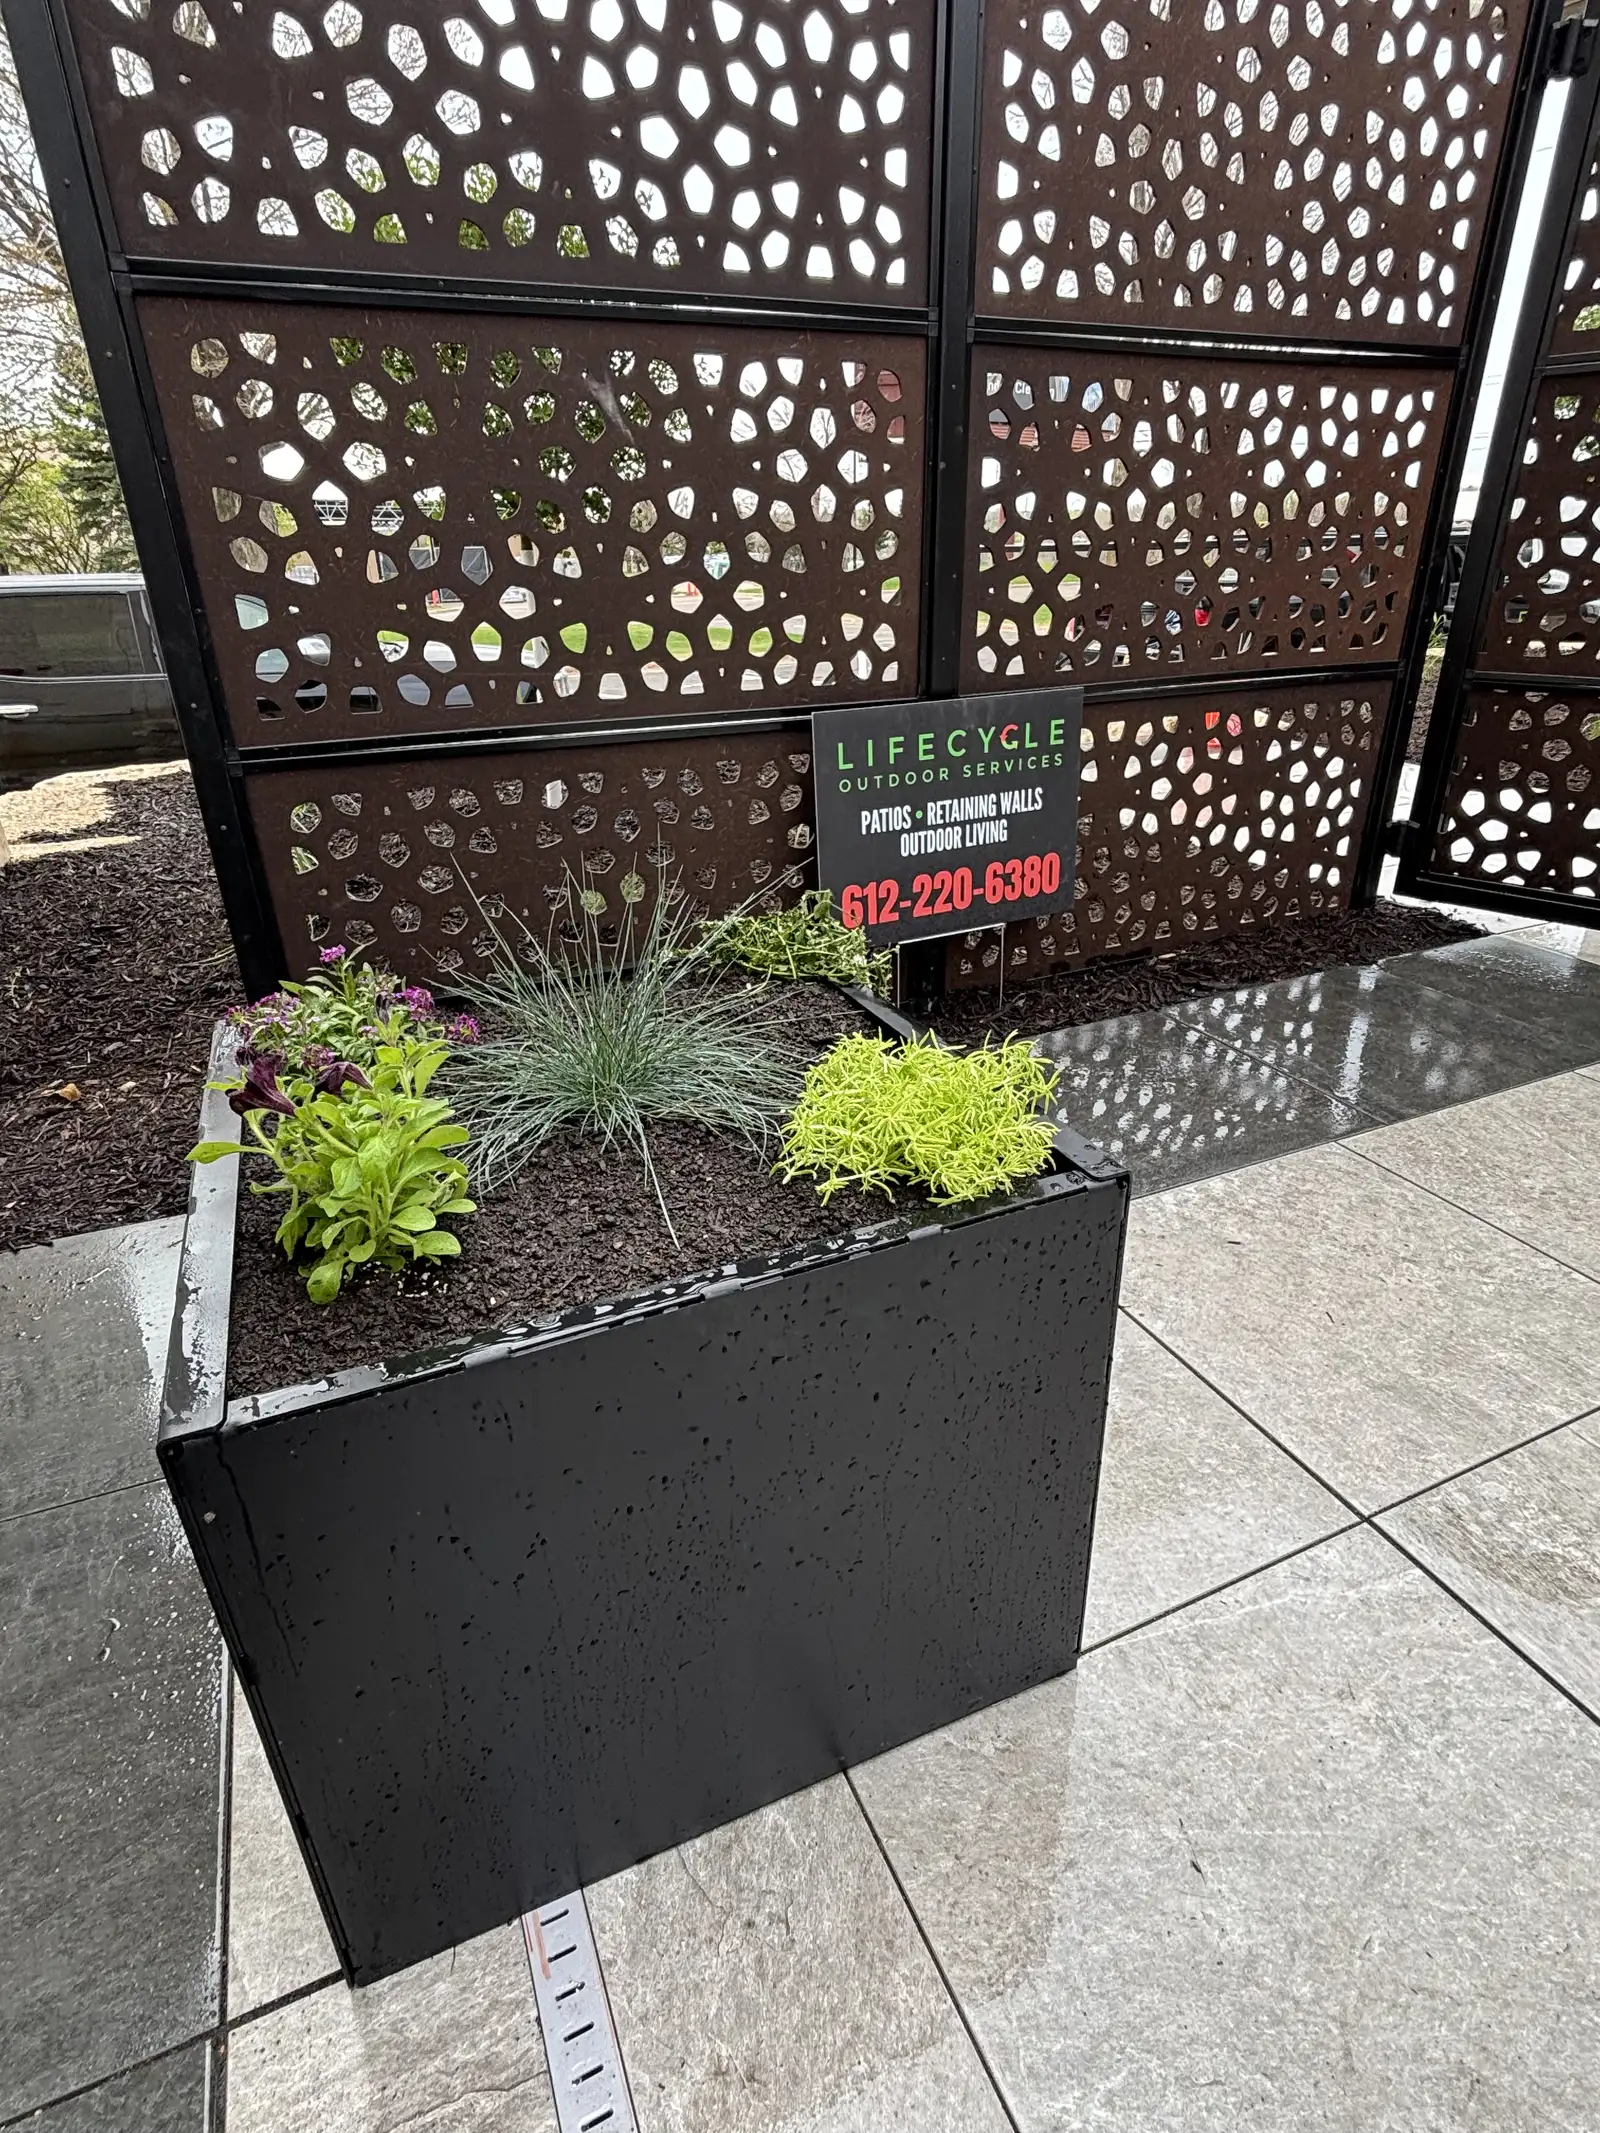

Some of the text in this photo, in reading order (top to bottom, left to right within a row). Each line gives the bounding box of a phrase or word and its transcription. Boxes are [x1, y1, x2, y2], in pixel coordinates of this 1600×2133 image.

[837, 719, 1064, 769] LIFECYCLE
[838, 753, 1063, 793] OUTDOOR SERVICES
[861, 787, 1044, 835] PATIOS RETAINING WALLS
[900, 819, 1008, 857] OUTDOOR LIVING
[841, 852, 1061, 930] 612-220-6380
